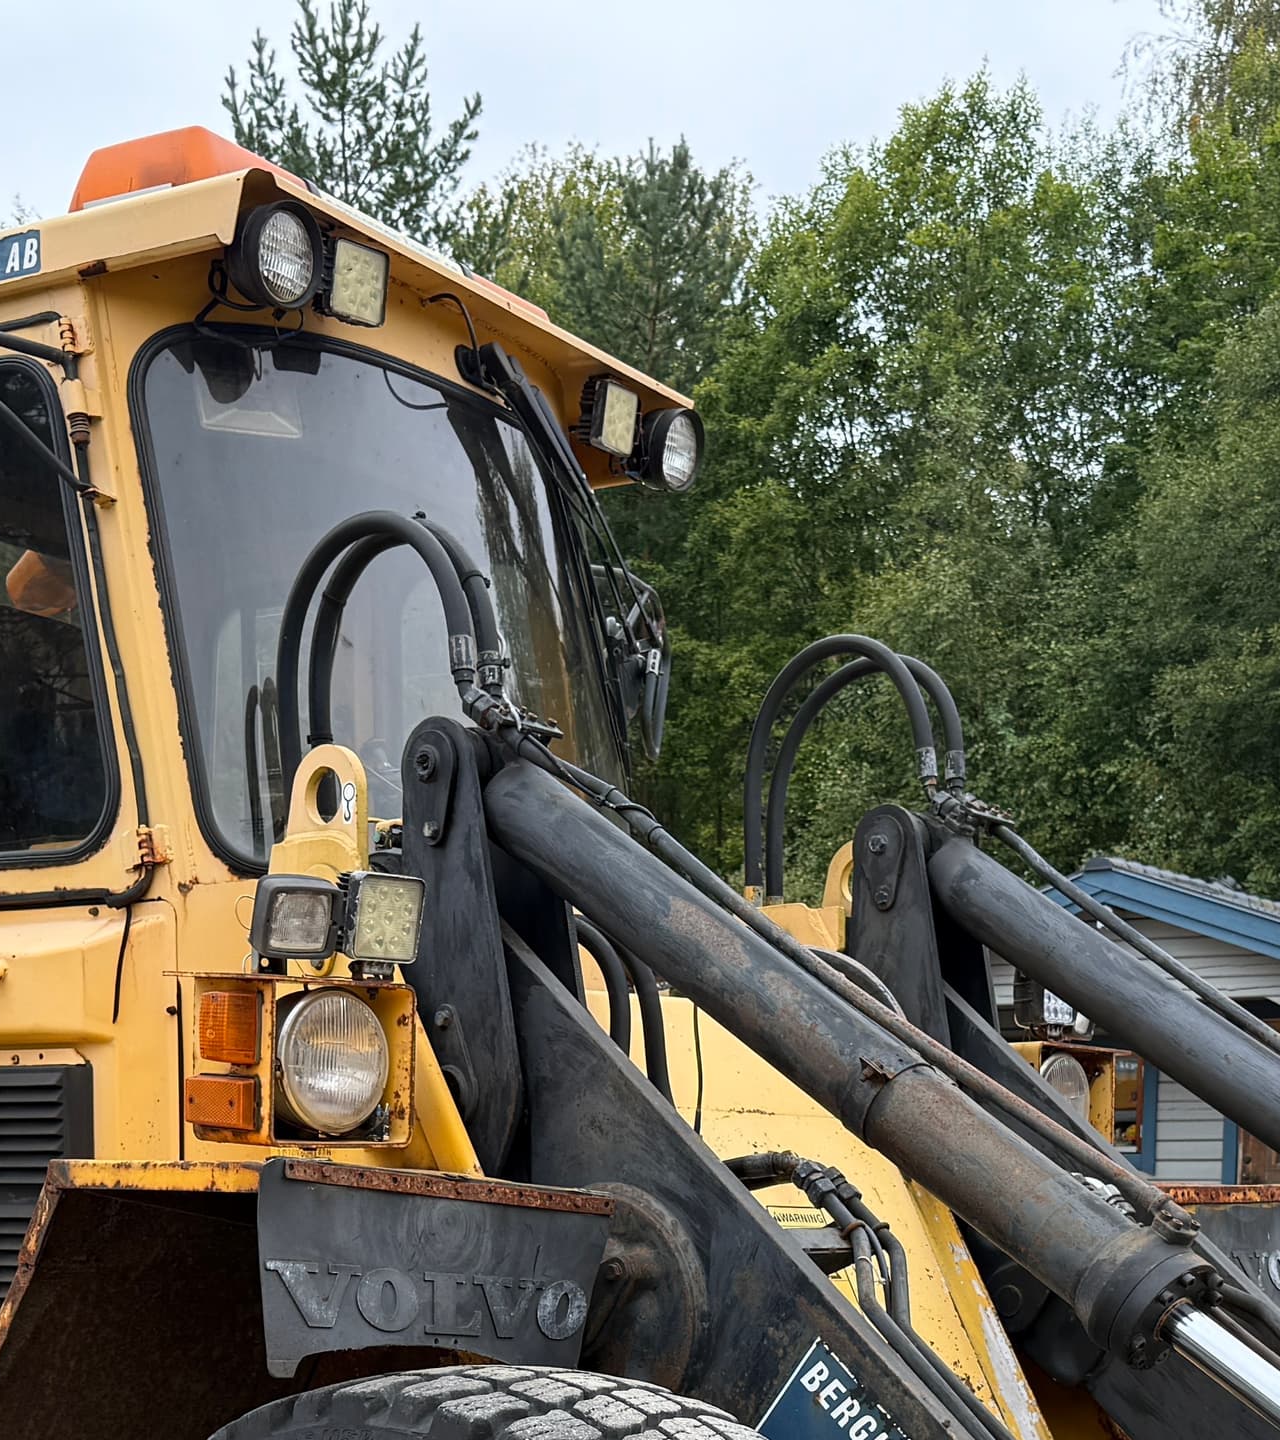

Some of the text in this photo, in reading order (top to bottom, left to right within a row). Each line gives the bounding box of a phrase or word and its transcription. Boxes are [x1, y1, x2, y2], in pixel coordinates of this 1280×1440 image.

[5, 237, 38, 274] AB
[779, 1211, 825, 1224] WARNING
[264, 1259, 587, 1341] VOLVO
